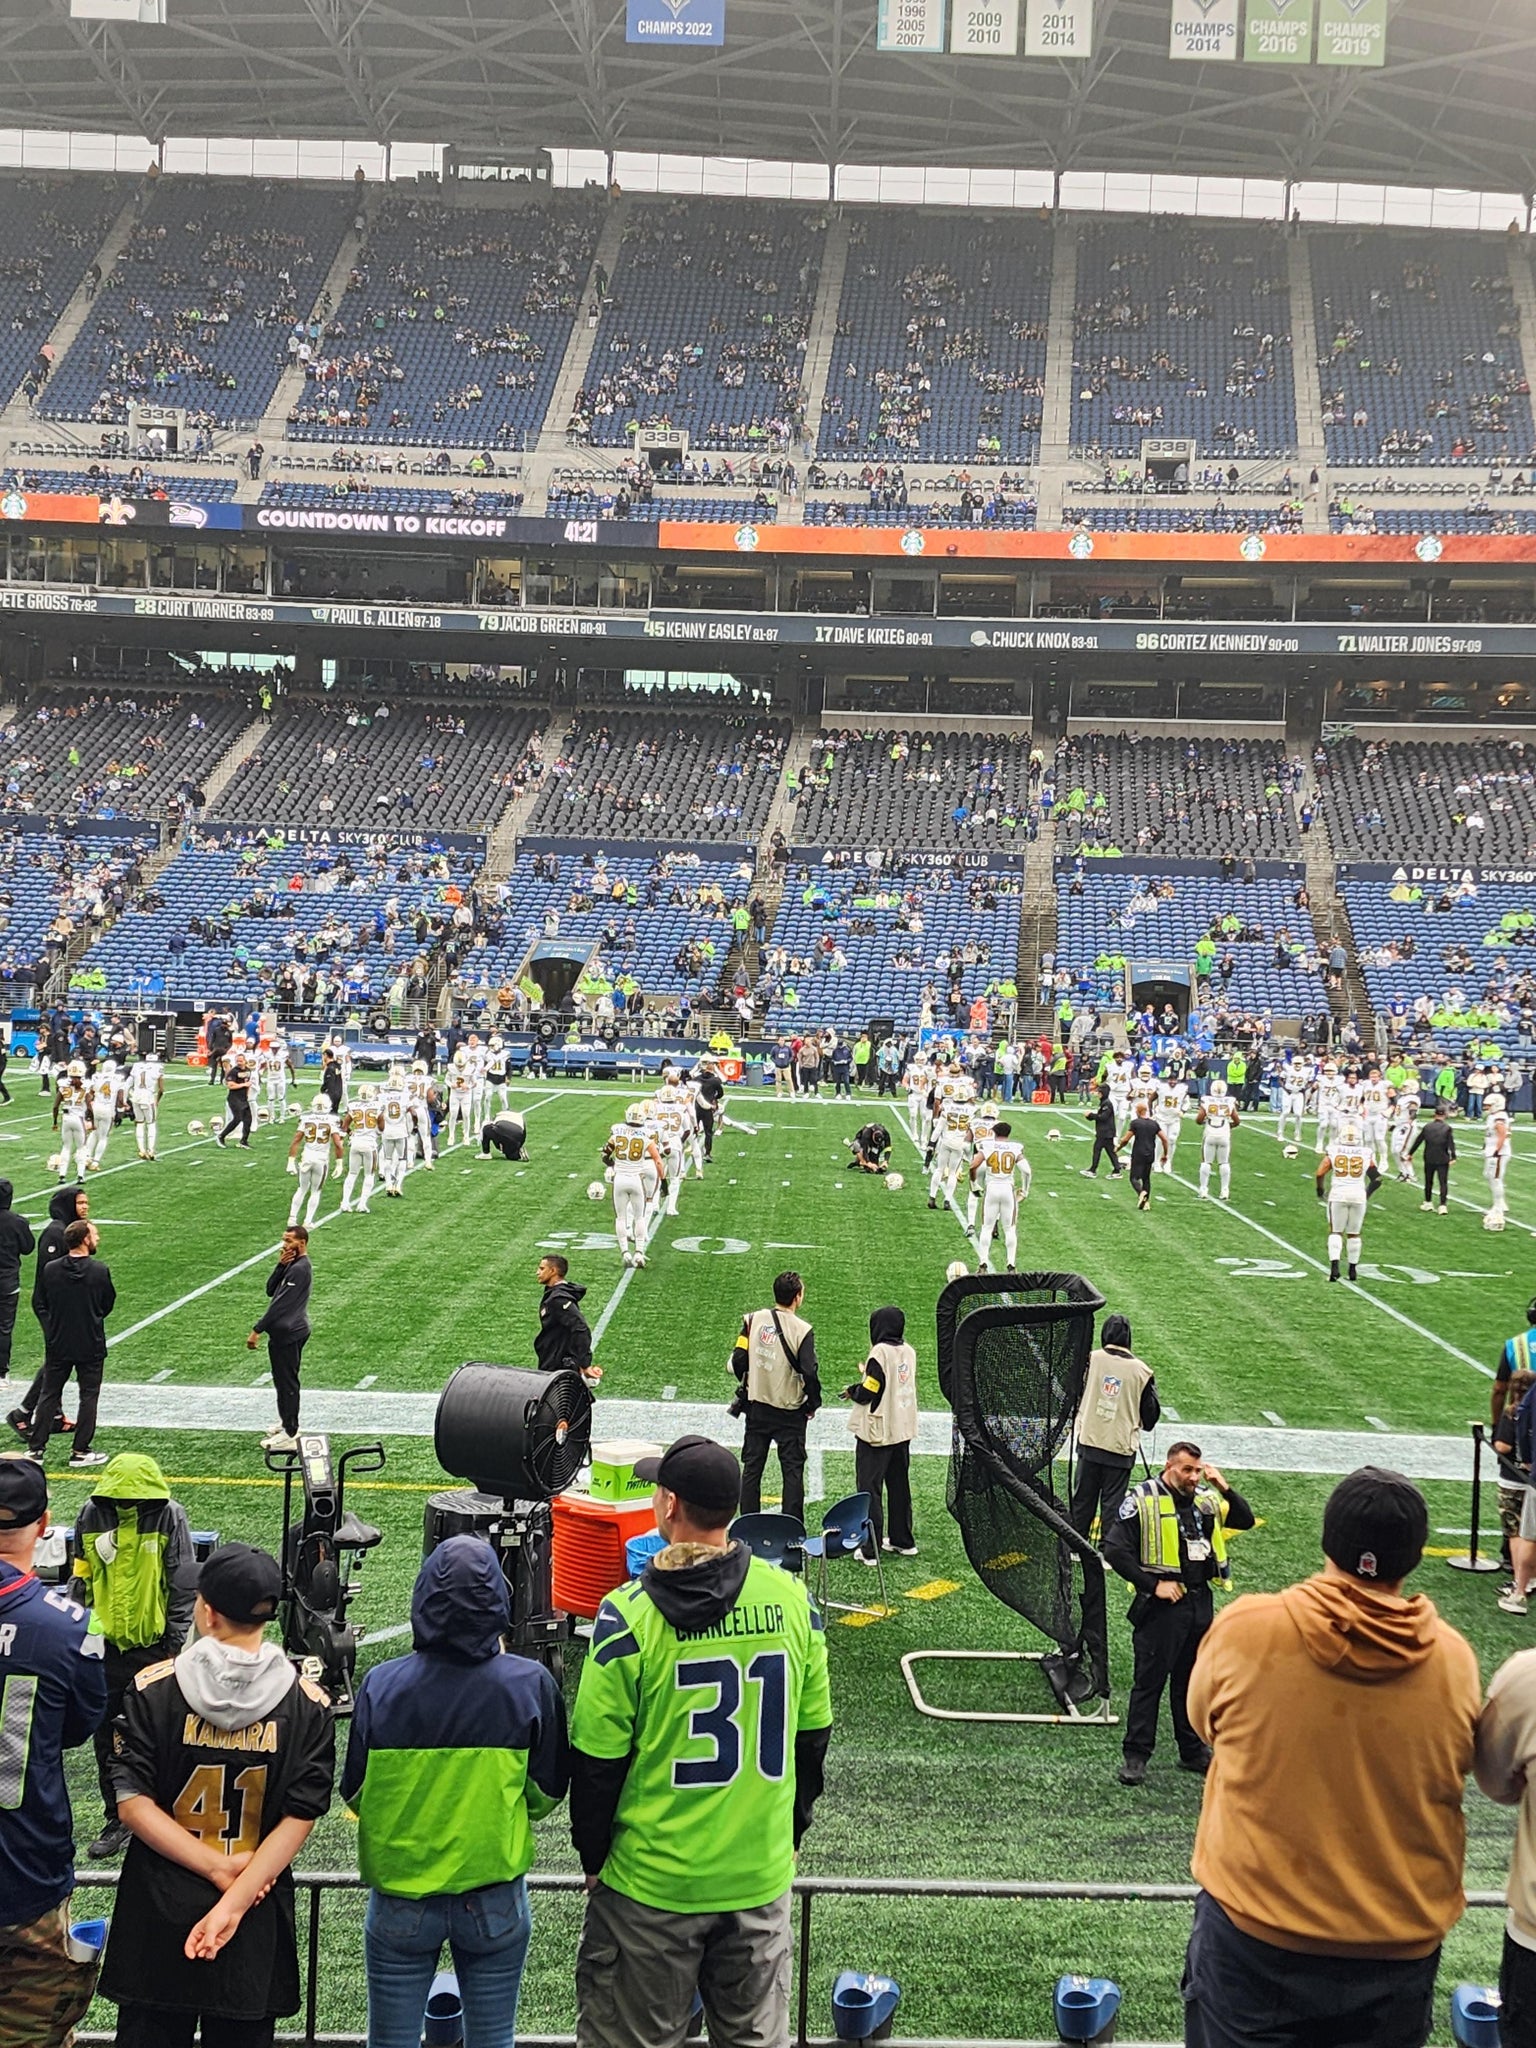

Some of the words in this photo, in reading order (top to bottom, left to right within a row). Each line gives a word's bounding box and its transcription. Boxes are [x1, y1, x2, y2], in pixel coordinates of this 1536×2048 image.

[898, 5, 926, 17] 1996
[967, 12, 1001, 27] 2009
[638, 20, 683, 35] CHAMPS
[685, 22, 712, 36] 2022
[896, 19, 925, 32] 2005
[1042, 14, 1075, 29] 2011
[1174, 22, 1235, 37] CHAMPS
[1250, 20, 1308, 37] CHAMPS
[1324, 22, 1381, 38] CHAMPS
[896, 33, 925, 46] 2007
[967, 29, 1001, 44] 2010
[1042, 31, 1075, 46] 2014
[1186, 38, 1221, 52] 2014
[1258, 36, 1298, 53] 2016
[1331, 38, 1371, 55] 2019
[140, 408, 178, 420] 334
[644, 431, 680, 442] 336
[1148, 441, 1187, 452] 338
[257, 510, 388, 532] COUNTDOWN
[394, 515, 421, 533] TO
[425, 517, 506, 537] KICKOFF
[563, 521, 598, 543] 41:21
[27, 594, 69, 610] GROSS
[69, 599, 97, 613] 76-92
[135, 598, 156, 615] 28
[157, 600, 190, 617] CURT
[192, 601, 245, 619] WARNER
[245, 607, 274, 621] 83-89
[331, 608, 361, 626] PAUL
[363, 610, 375, 627] G.
[377, 610, 414, 628] ALLEN
[414, 615, 441, 629] 97-18
[478, 614, 499, 631] 79
[499, 615, 537, 633] JACOB
[539, 617, 579, 634] GREEN
[580, 621, 607, 635] 80-91
[644, 621, 665, 638] 45
[666, 621, 706, 639] KENNY
[708, 623, 752, 640] EASLEY
[753, 628, 779, 642] 81-87
[815, 626, 834, 643] 17
[834, 627, 864, 644] DAVE
[867, 627, 905, 645] KRIEG
[906, 632, 933, 646] 80-91
[992, 631, 1034, 648] CHUCK
[1036, 631, 1070, 648] KNOX
[1071, 636, 1099, 649] 83-91
[1136, 633, 1160, 650] 96
[1159, 633, 1207, 650] CORTEZ
[1209, 634, 1268, 651] KENNEDY
[1268, 639, 1299, 652] 90-00
[1337, 635, 1357, 652] 71
[1357, 635, 1409, 653] WALTER
[1409, 636, 1451, 653] JONES
[1451, 640, 1482, 653] 97-09
[274, 828, 331, 842] DELTA
[963, 854, 988, 867] LUB
[1412, 868, 1474, 882] DELTA
[1156, 1038, 1178, 1053] 12
[723, 1063, 736, 1076] G
[62, 1086, 86, 1105] 27
[101, 1081, 112, 1100] 4
[352, 1109, 377, 1129] 26
[388, 1101, 400, 1120] 0
[304, 1122, 331, 1144] 33
[615, 1135, 644, 1161] 28
[986, 1151, 1015, 1174] 40
[671, 1651, 789, 1788] 31
[182, 1713, 278, 1754] KAMARA
[172, 1764, 268, 1857] 41
